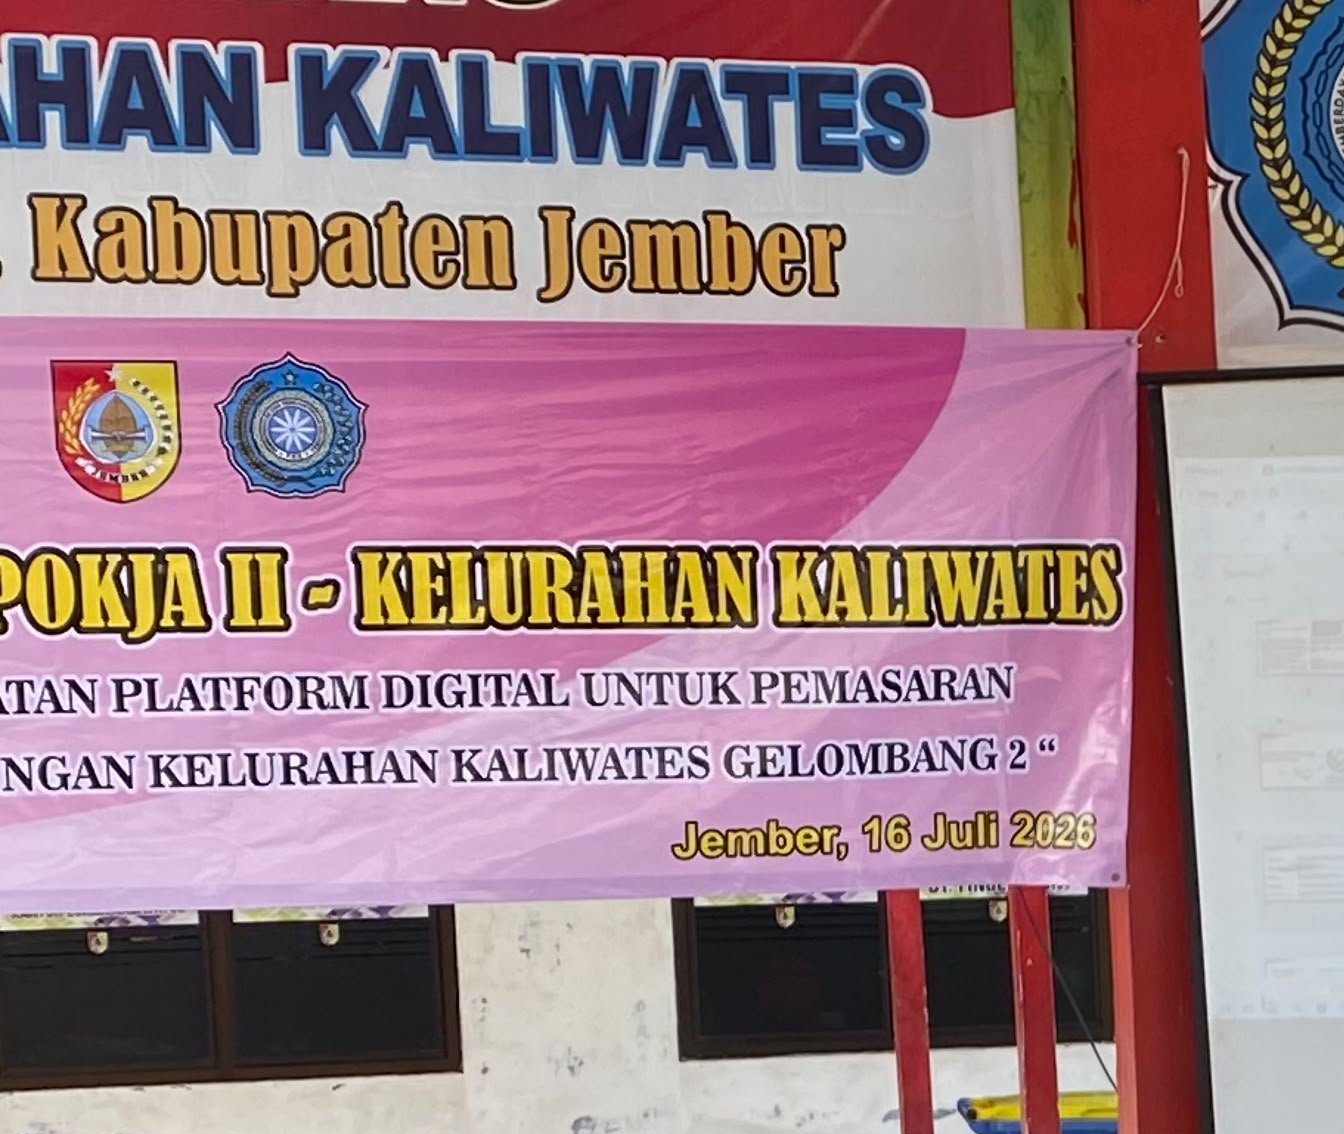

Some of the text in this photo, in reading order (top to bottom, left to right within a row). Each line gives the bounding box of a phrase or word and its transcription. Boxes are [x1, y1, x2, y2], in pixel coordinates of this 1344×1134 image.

[0, 38, 930, 175] HAN KALIWATES
[28, 193, 846, 303] Kabupaten Jember
[219, 546, 292, 632] II
[352, 545, 760, 631] KELURAHAN
[771, 543, 1123, 628] KALIWATES
[111, 675, 370, 713] PLATFORM
[381, 672, 570, 709] DIGITAL
[582, 670, 743, 708] UNTUK
[750, 665, 1014, 705] PEMASARAN
[1, 754, 136, 791] NGAN
[149, 749, 439, 788] KELURAHAN
[451, 744, 711, 784] KALIWATES
[723, 737, 998, 778] GELOMBANG
[1009, 739, 1028, 770] 2
[671, 809, 1097, 861] Jember, 16 Juli 2026
